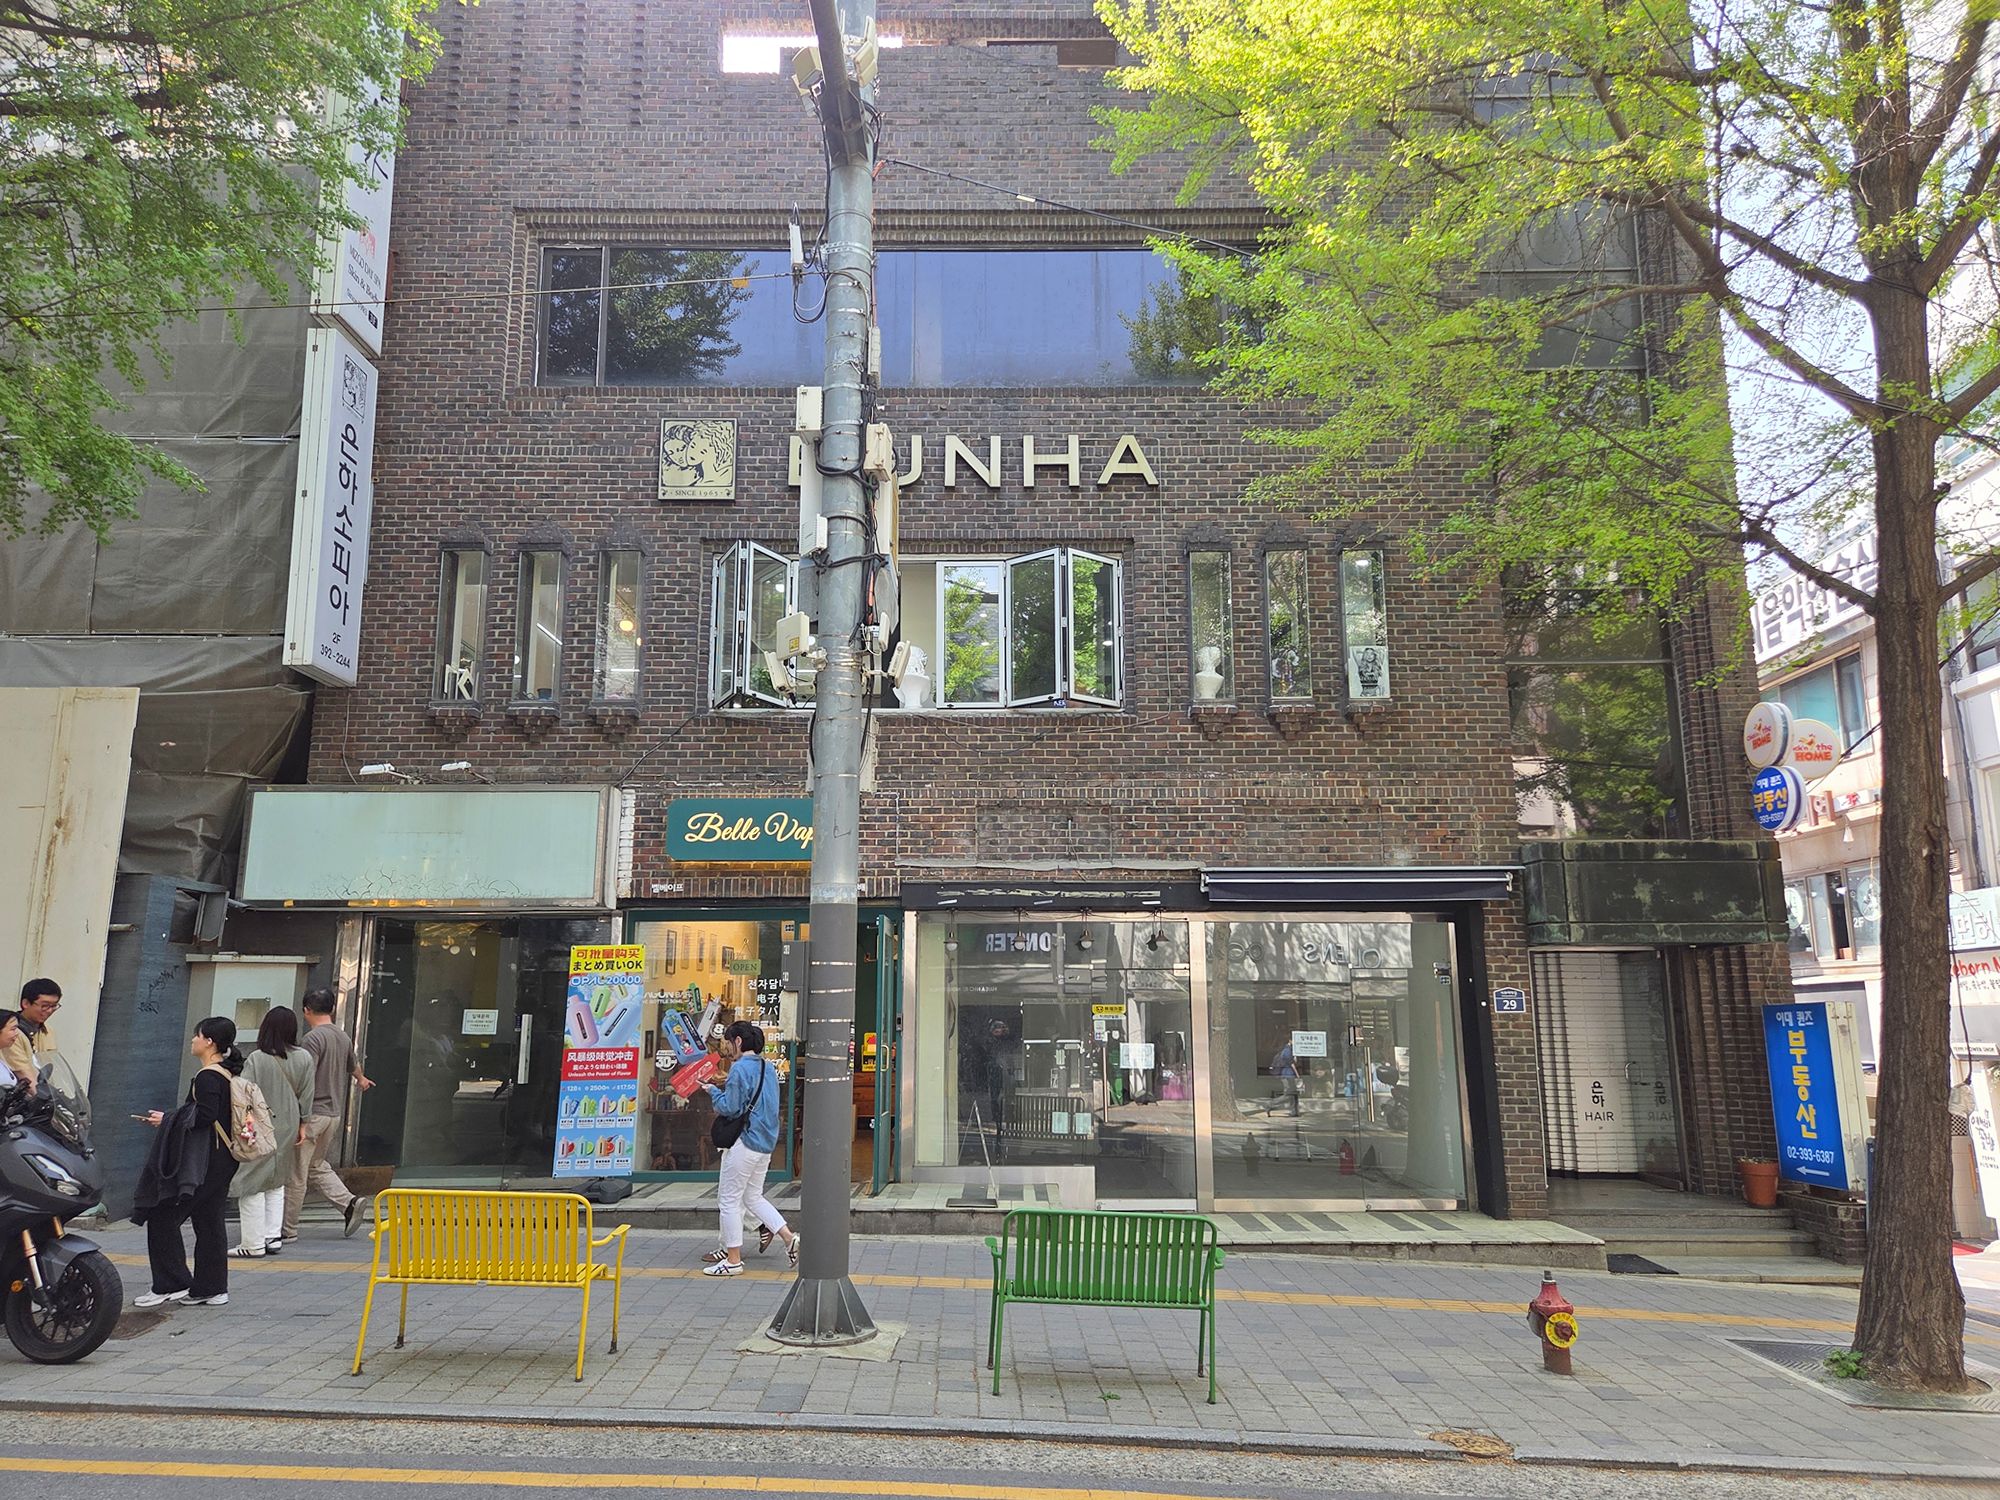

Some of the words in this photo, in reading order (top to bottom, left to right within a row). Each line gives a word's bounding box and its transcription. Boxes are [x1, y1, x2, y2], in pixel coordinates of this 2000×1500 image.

[348, 263, 360, 284] Skin
[366, 283, 380, 307] Body
[788, 434, 1159, 488] UNHA
[328, 423, 360, 627] 은하소피아
[332, 632, 342, 644] 2F
[320, 644, 351, 670] 392-2244
[1752, 735, 1772, 750] HOME
[1795, 751, 1832, 761] HOME
[1753, 786, 1788, 813] 부동산
[684, 811, 760, 844] Belle
[1853, 916, 1865, 928] 2F
[573, 960, 643, 972] まとめ買いOK
[733, 962, 757, 972] OPEN
[1951, 959, 1991, 976] eborn
[571, 975, 604, 986] OPAL
[606, 975, 641, 986] 20000
[747, 979, 784, 990] 전자담
[757, 993, 782, 1004] 电子
[1502, 1000, 1517, 1010] 29
[1776, 1011, 1793, 1027] 이대
[1787, 1029, 1818, 1140] 부동산
[1591, 1081, 1605, 1107] 은하
[1584, 1112, 1615, 1121] HAIR
[1786, 1146, 1835, 1165] 02-393-6387
